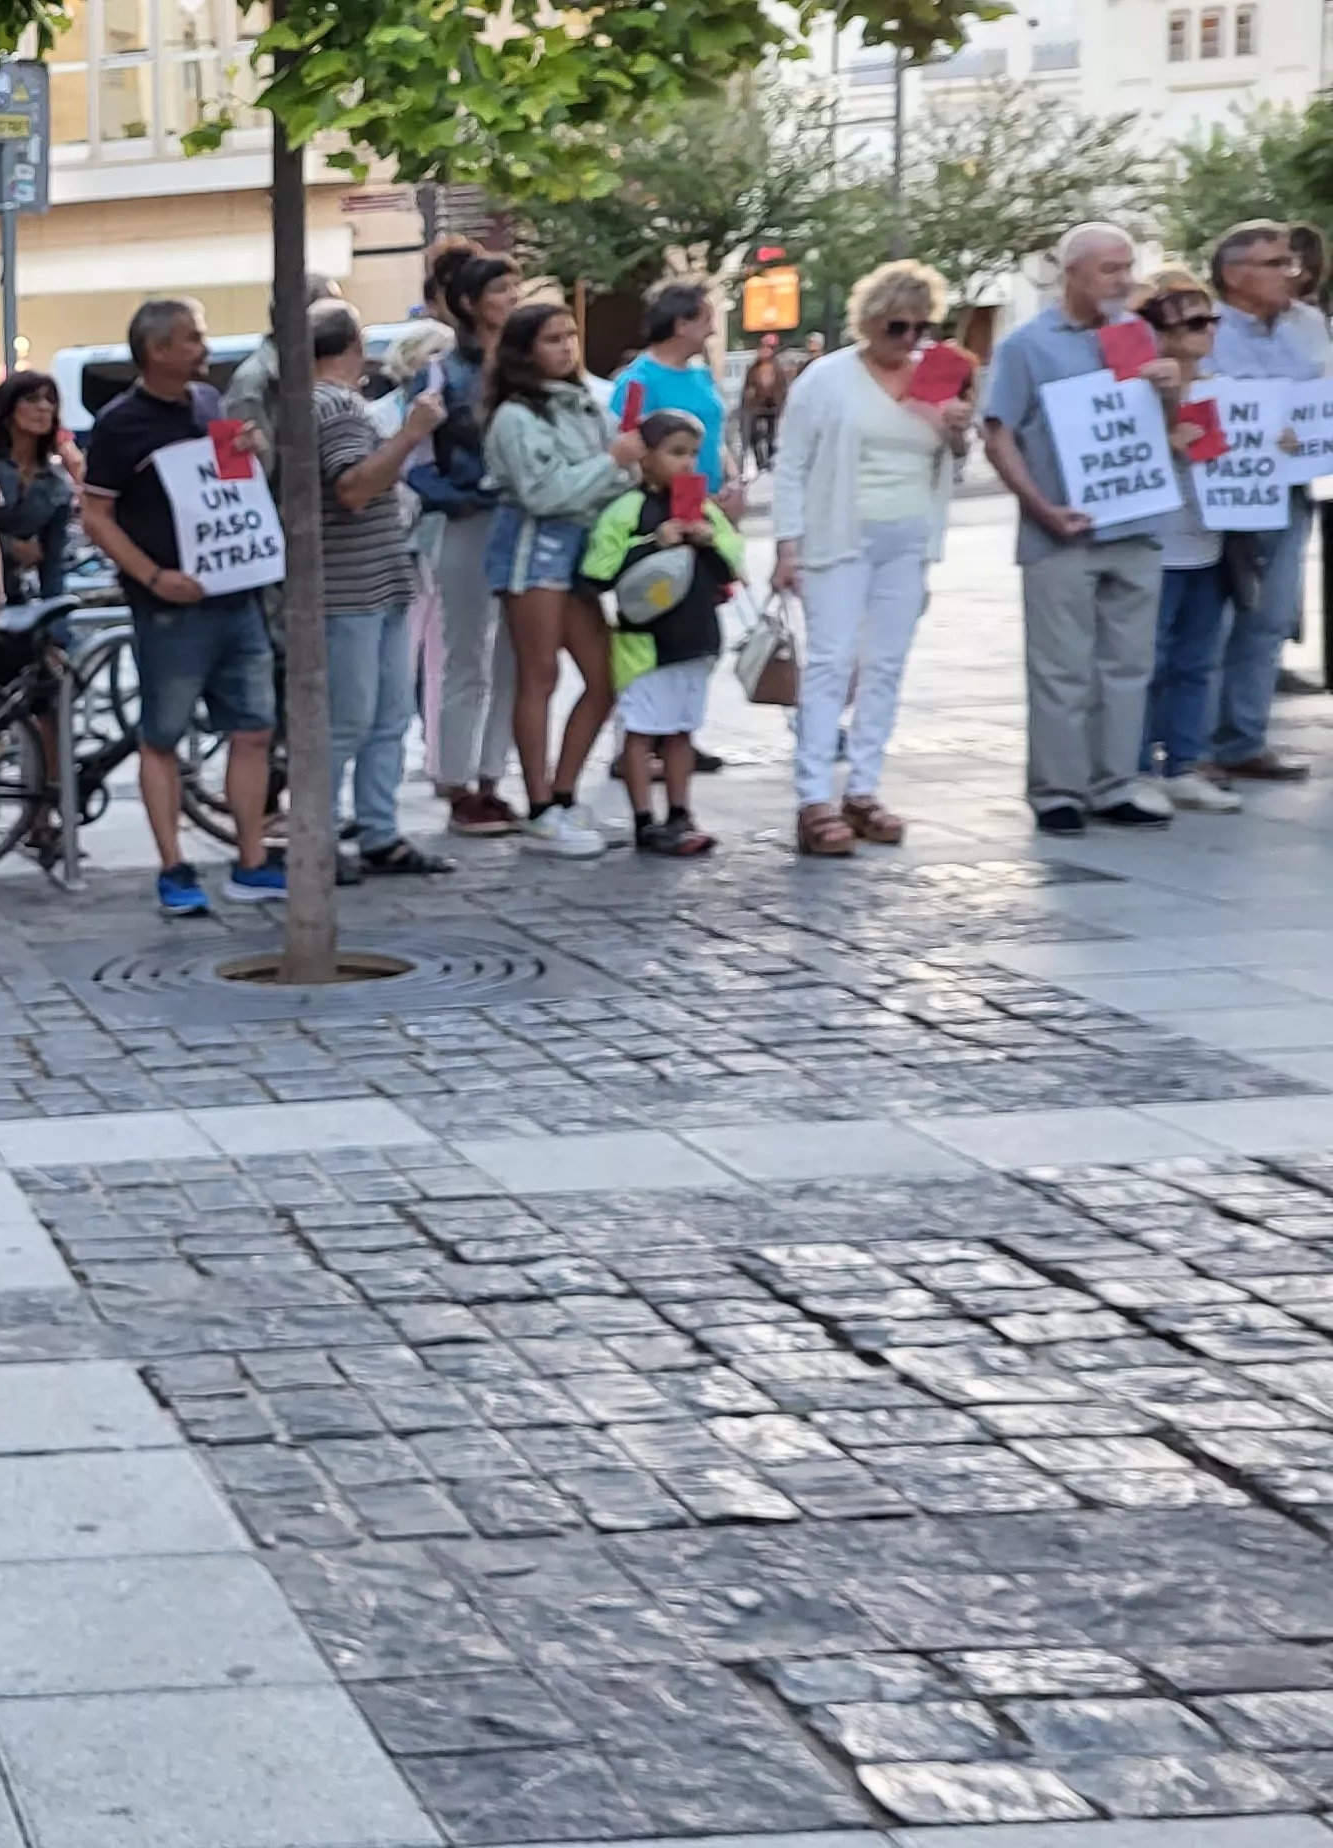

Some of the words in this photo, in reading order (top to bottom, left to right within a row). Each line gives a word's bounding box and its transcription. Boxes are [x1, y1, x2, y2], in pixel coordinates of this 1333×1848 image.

[1091, 391, 1125, 414] NI
[1228, 402, 1259, 422] NI
[1091, 416, 1137, 442] UN
[1081, 441, 1153, 474] PASO
[1205, 455, 1276, 478] PASO
[196, 459, 219, 483] N
[201, 484, 242, 510] UN
[1082, 467, 1167, 504] ATRÁS
[195, 509, 262, 544] PASO
[195, 534, 280, 575] ATRÁS
